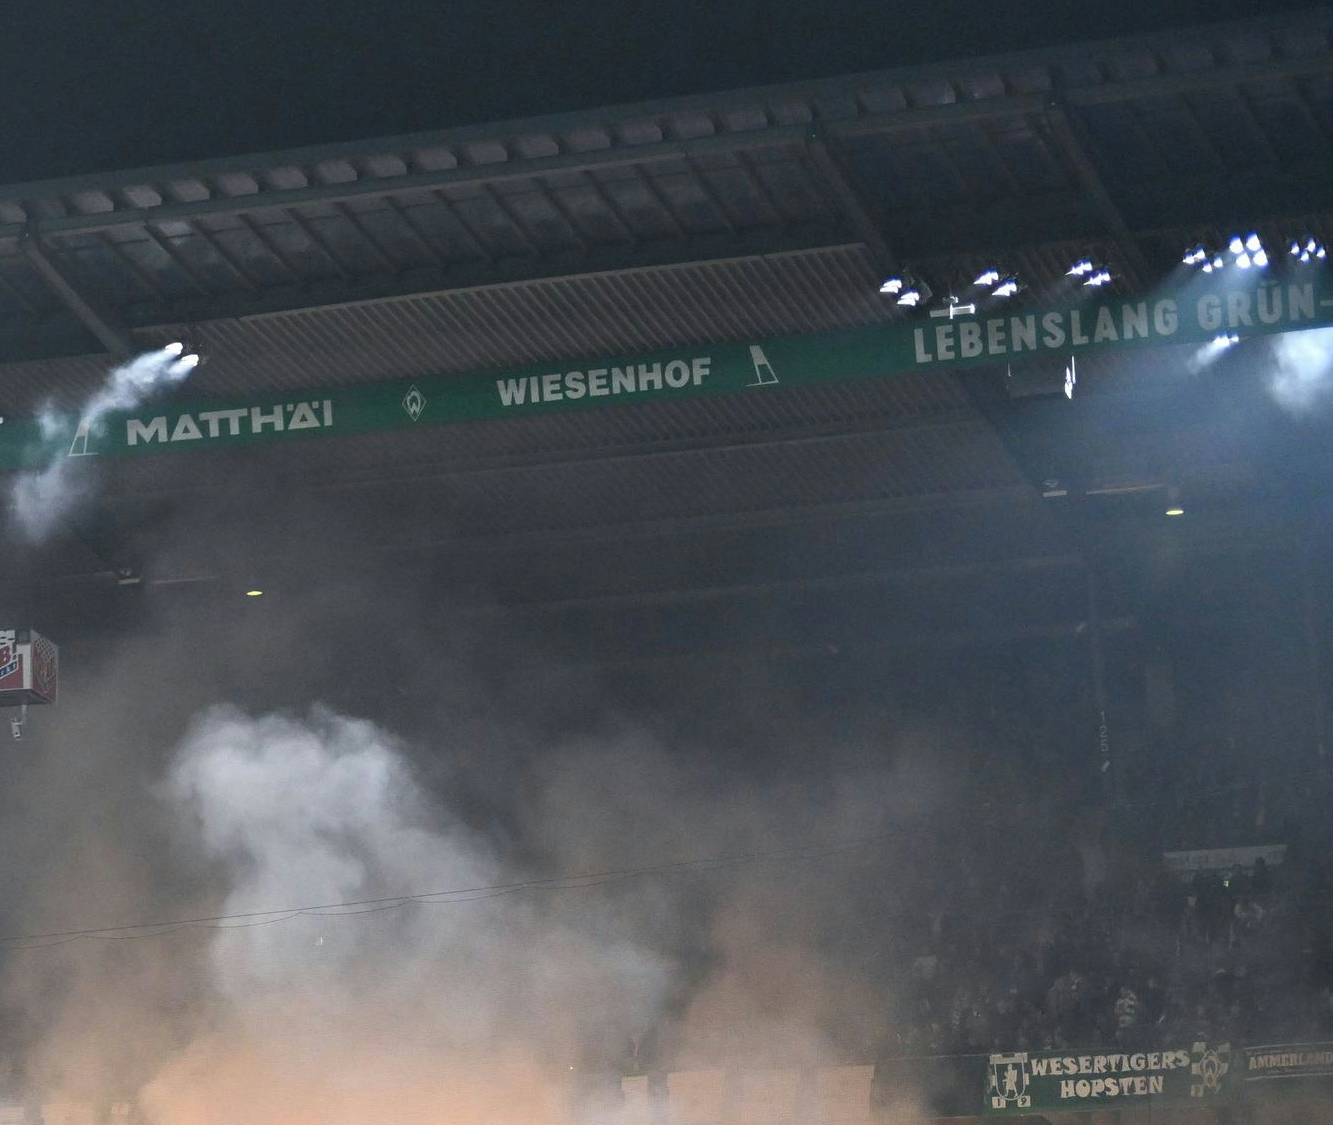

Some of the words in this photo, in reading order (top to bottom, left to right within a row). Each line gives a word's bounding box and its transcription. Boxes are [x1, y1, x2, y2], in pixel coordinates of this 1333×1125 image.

[914, 301, 1179, 364] LEBENSLANG
[495, 357, 712, 406] WIESENHOF
[126, 399, 333, 446] MATTHÄI
[1030, 1050, 1190, 1076] WESERTIGERS
[1060, 1075, 1164, 1099] HOPSTEN
